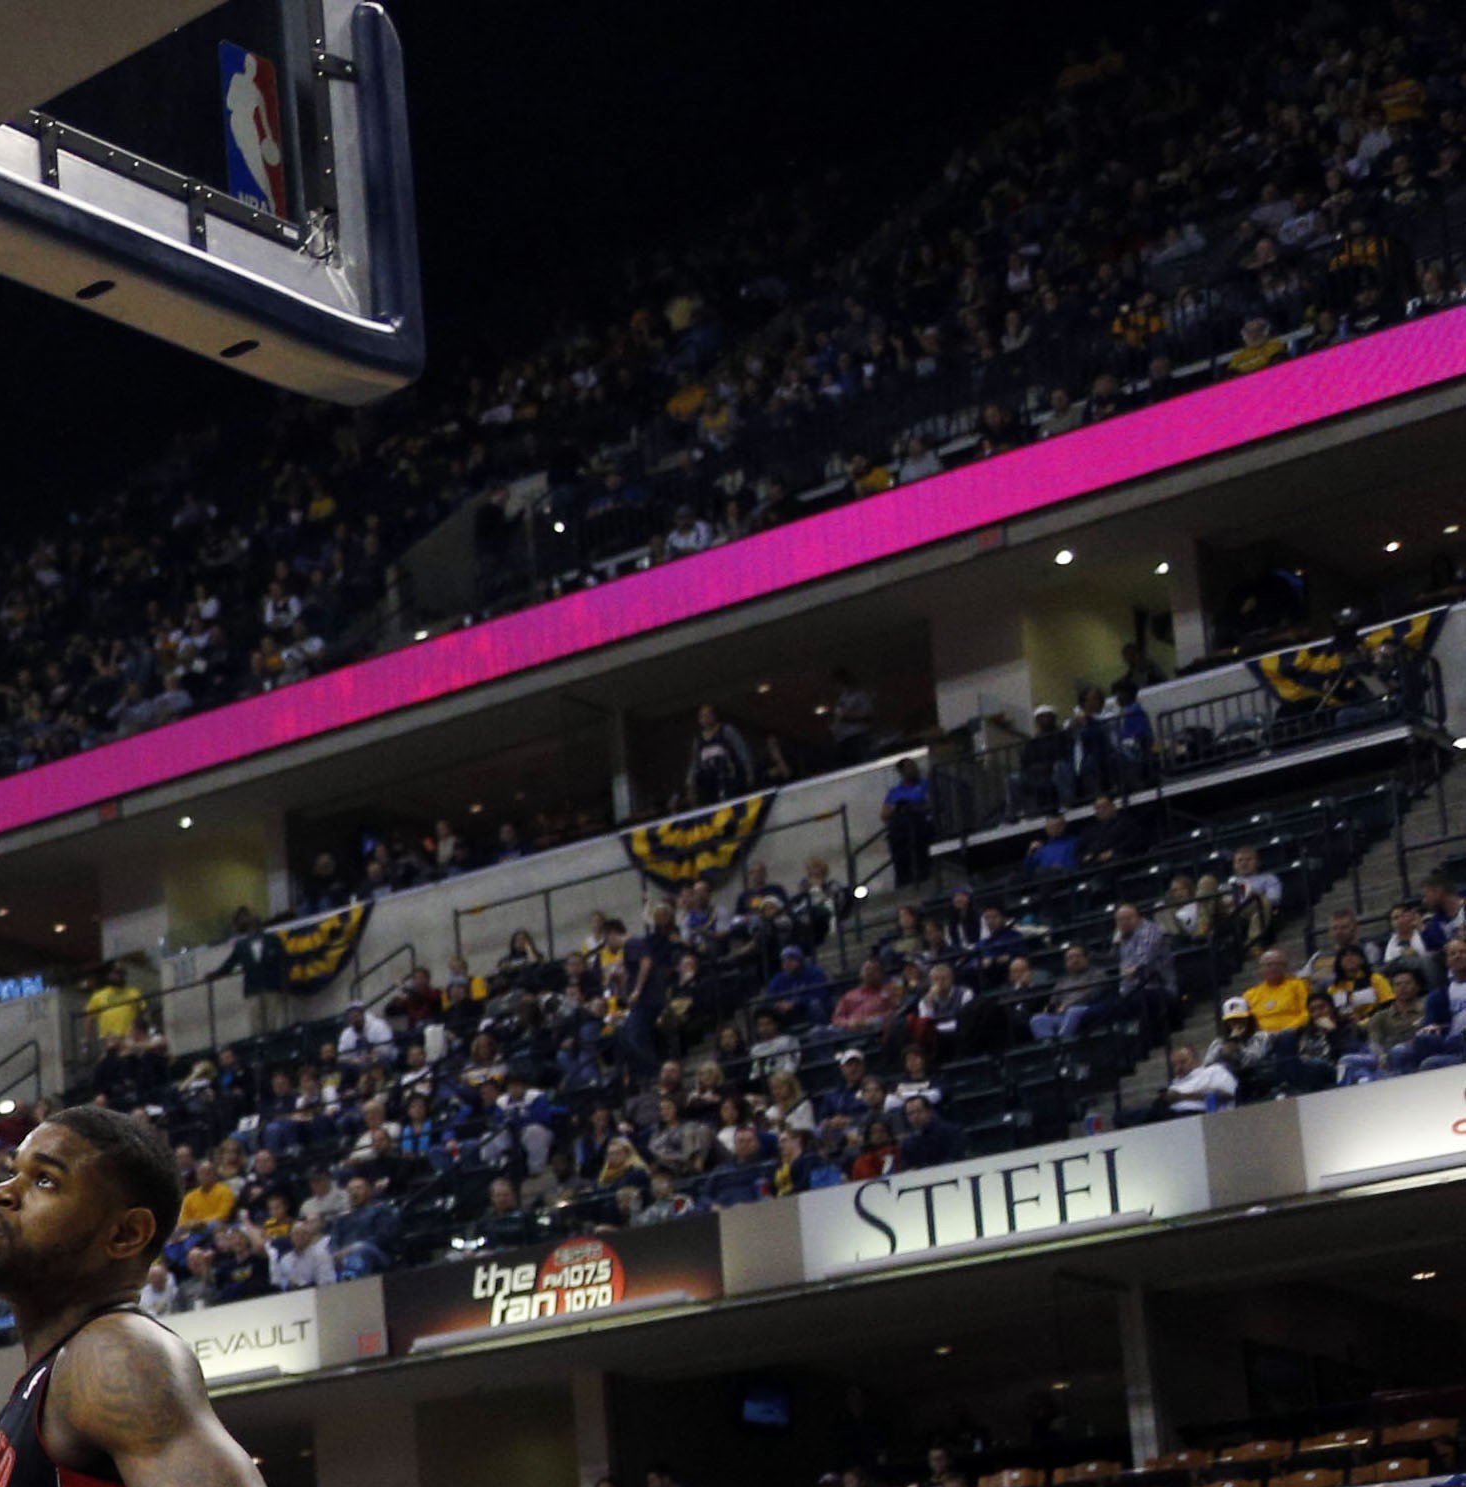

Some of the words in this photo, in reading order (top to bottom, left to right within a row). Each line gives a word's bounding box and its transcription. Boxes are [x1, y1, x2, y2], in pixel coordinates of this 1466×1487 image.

[854, 1147, 1156, 1263] STIFEL
[473, 1263, 537, 1299] the
[565, 1283, 613, 1314] 1070
[490, 1289, 558, 1328] fan
